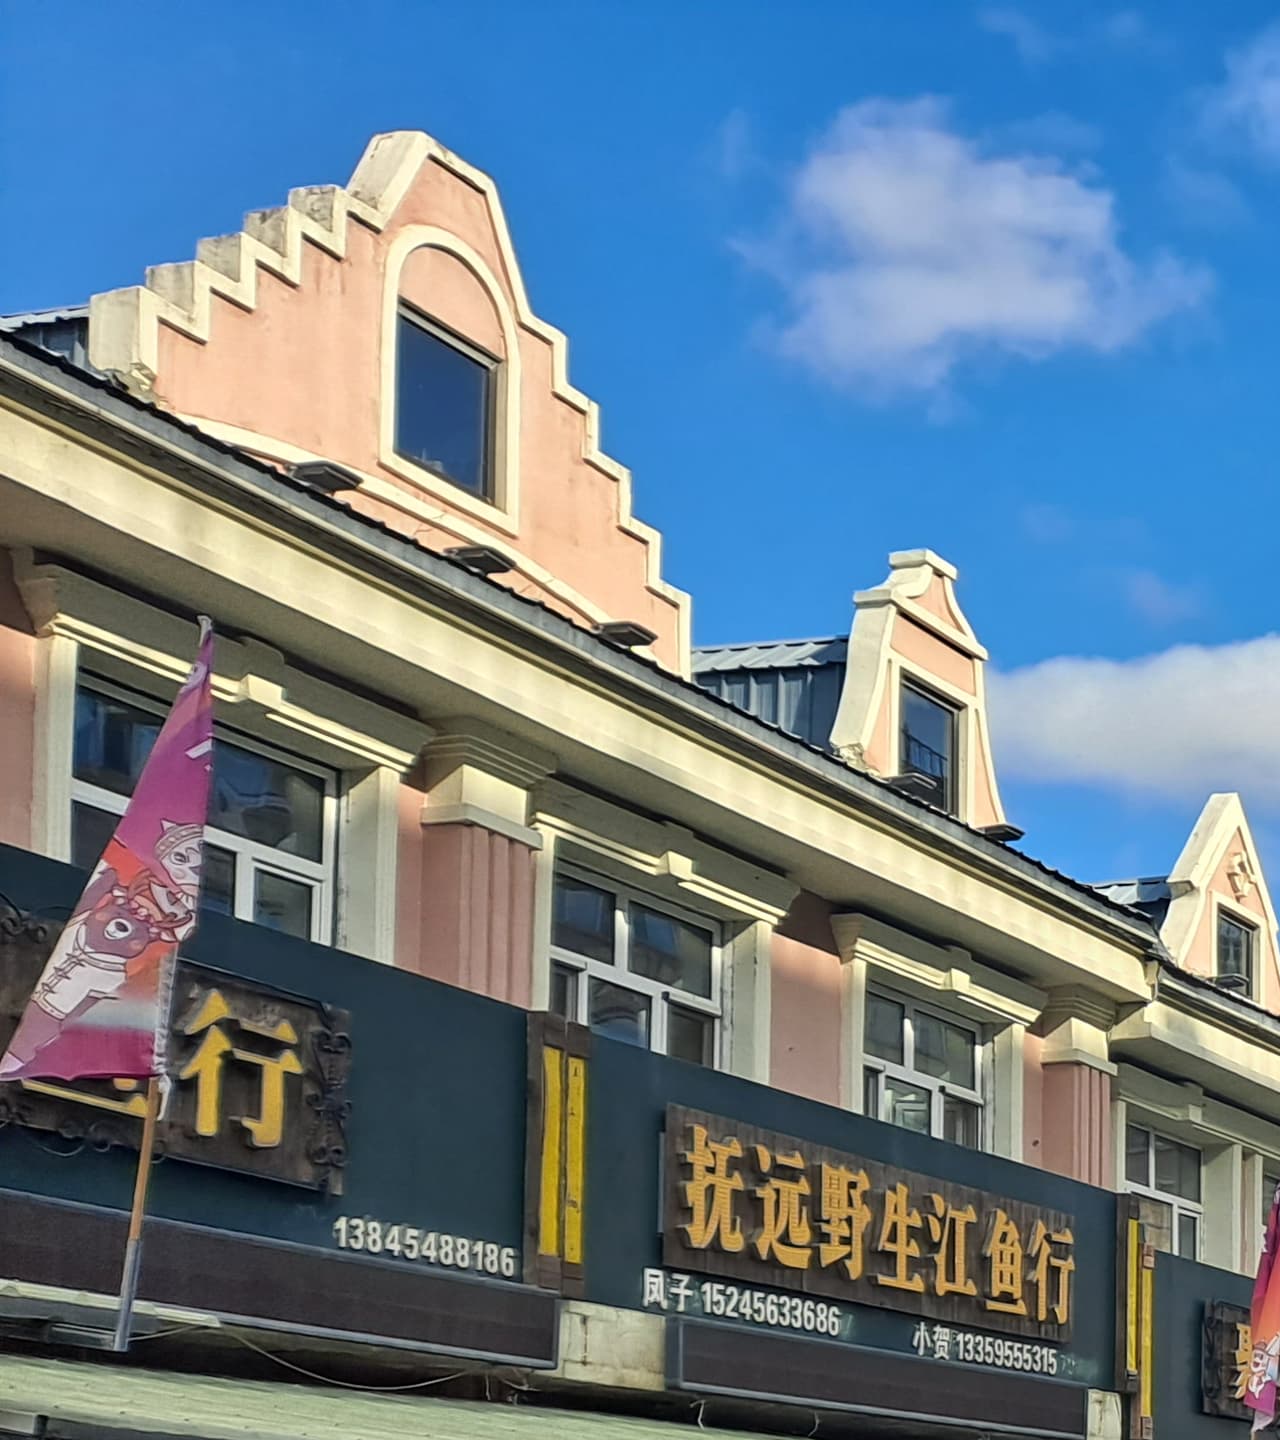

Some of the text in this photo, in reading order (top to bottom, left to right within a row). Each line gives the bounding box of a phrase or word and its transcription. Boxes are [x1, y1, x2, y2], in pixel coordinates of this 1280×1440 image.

[334, 1216, 514, 1277] 13845488186
[684, 1124, 1075, 1324] 抚远野生江鱼行
[701, 1282, 841, 1336] 15245633686
[912, 1322, 1058, 1375] 小贺 13359555315
